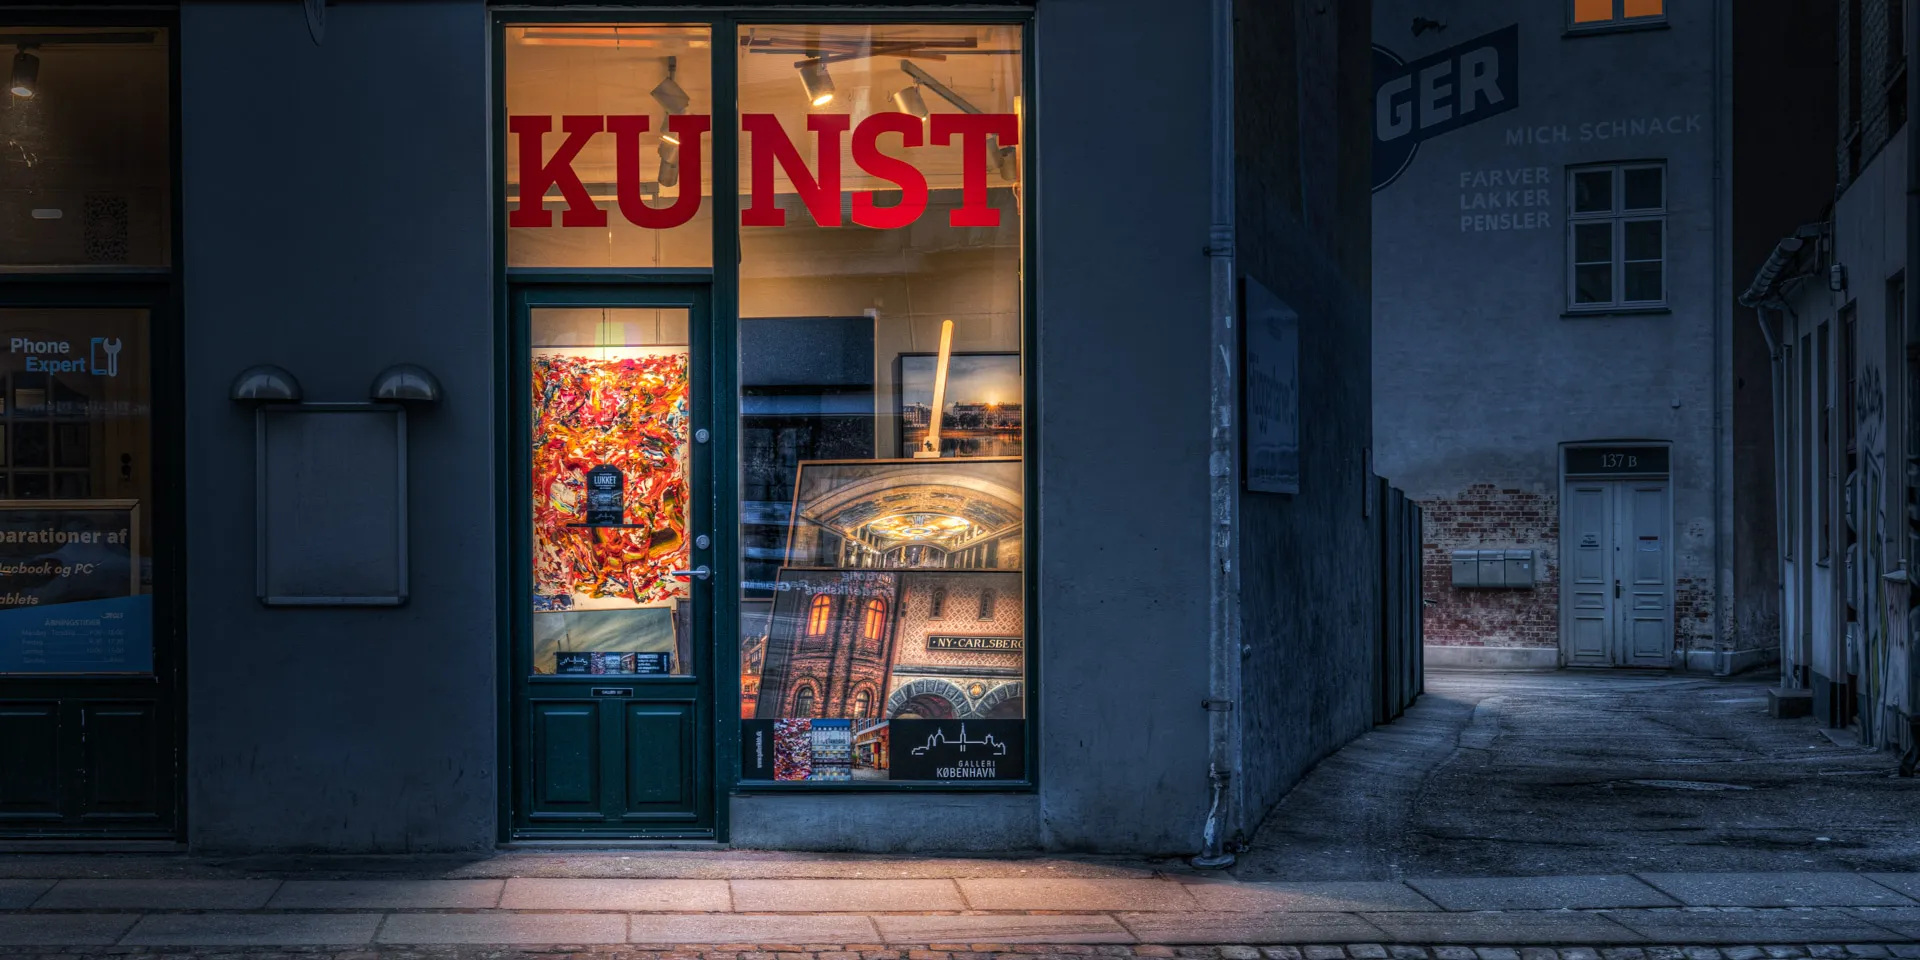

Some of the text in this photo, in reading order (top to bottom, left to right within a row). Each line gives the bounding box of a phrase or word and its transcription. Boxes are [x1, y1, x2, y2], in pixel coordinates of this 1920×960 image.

[1376, 46, 1505, 142] GER
[1505, 114, 1701, 147] MICH. SCHNACK
[509, 112, 1019, 229] KUNST
[1460, 167, 1550, 188] FARVER
[1460, 190, 1550, 210] LAKKER
[1461, 212, 1551, 232] PENSLER
[10, 338, 70, 353] Phone
[26, 356, 86, 375] Expert
[1601, 453, 1637, 467] 137 B
[594, 475, 617, 485] LUKKET
[107, 528, 128, 544] af
[54, 566, 71, 577] og
[74, 563, 94, 574] PC
[936, 767, 996, 778] KØBENHAVN
